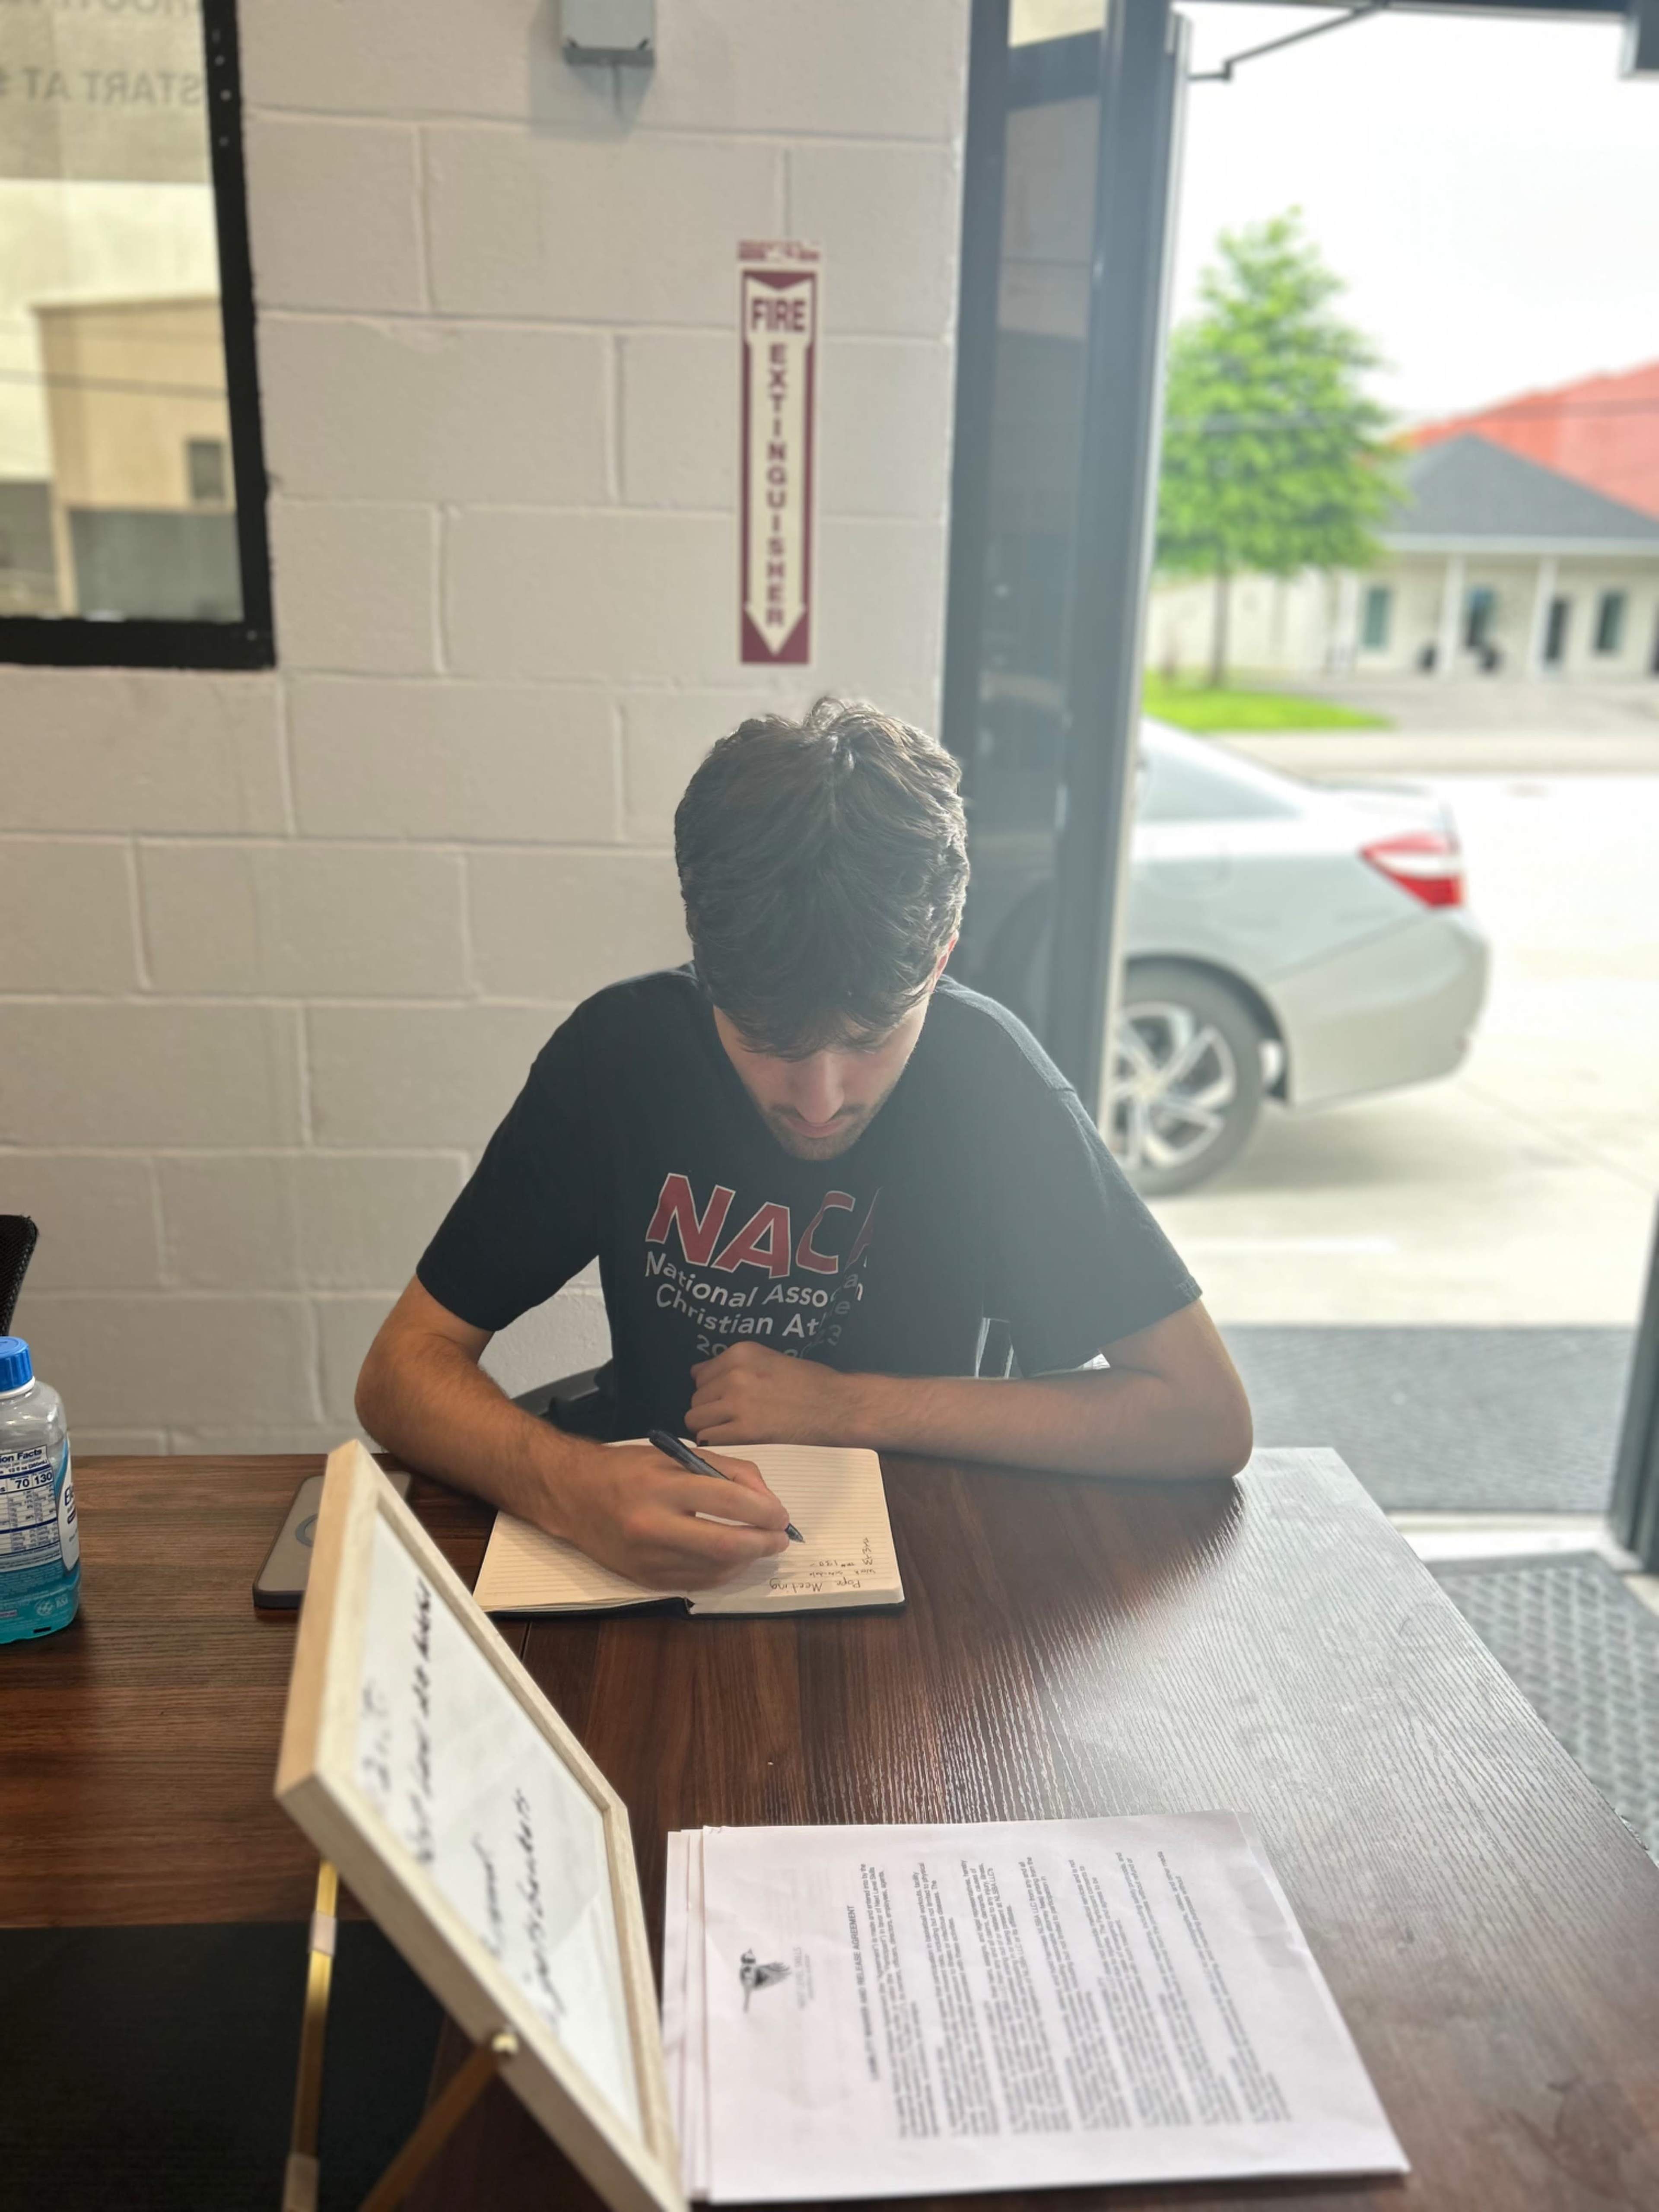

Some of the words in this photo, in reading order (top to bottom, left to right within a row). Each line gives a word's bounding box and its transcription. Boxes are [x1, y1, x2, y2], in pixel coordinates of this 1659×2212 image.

[752, 298, 805, 331] FIRE
[765, 343, 788, 628] EXTINGUISHER
[645, 1251, 758, 1307] National
[656, 1283, 773, 1335] Christian
[17, 1449, 42, 1460] Facts
[15, 1478, 29, 1489] 70
[35, 1472, 52, 1484] 130
[769, 1578, 823, 1592] Meeting
[846, 1905, 860, 1950] AGREEMENT
[853, 1951, 865, 1985] RELEASE
